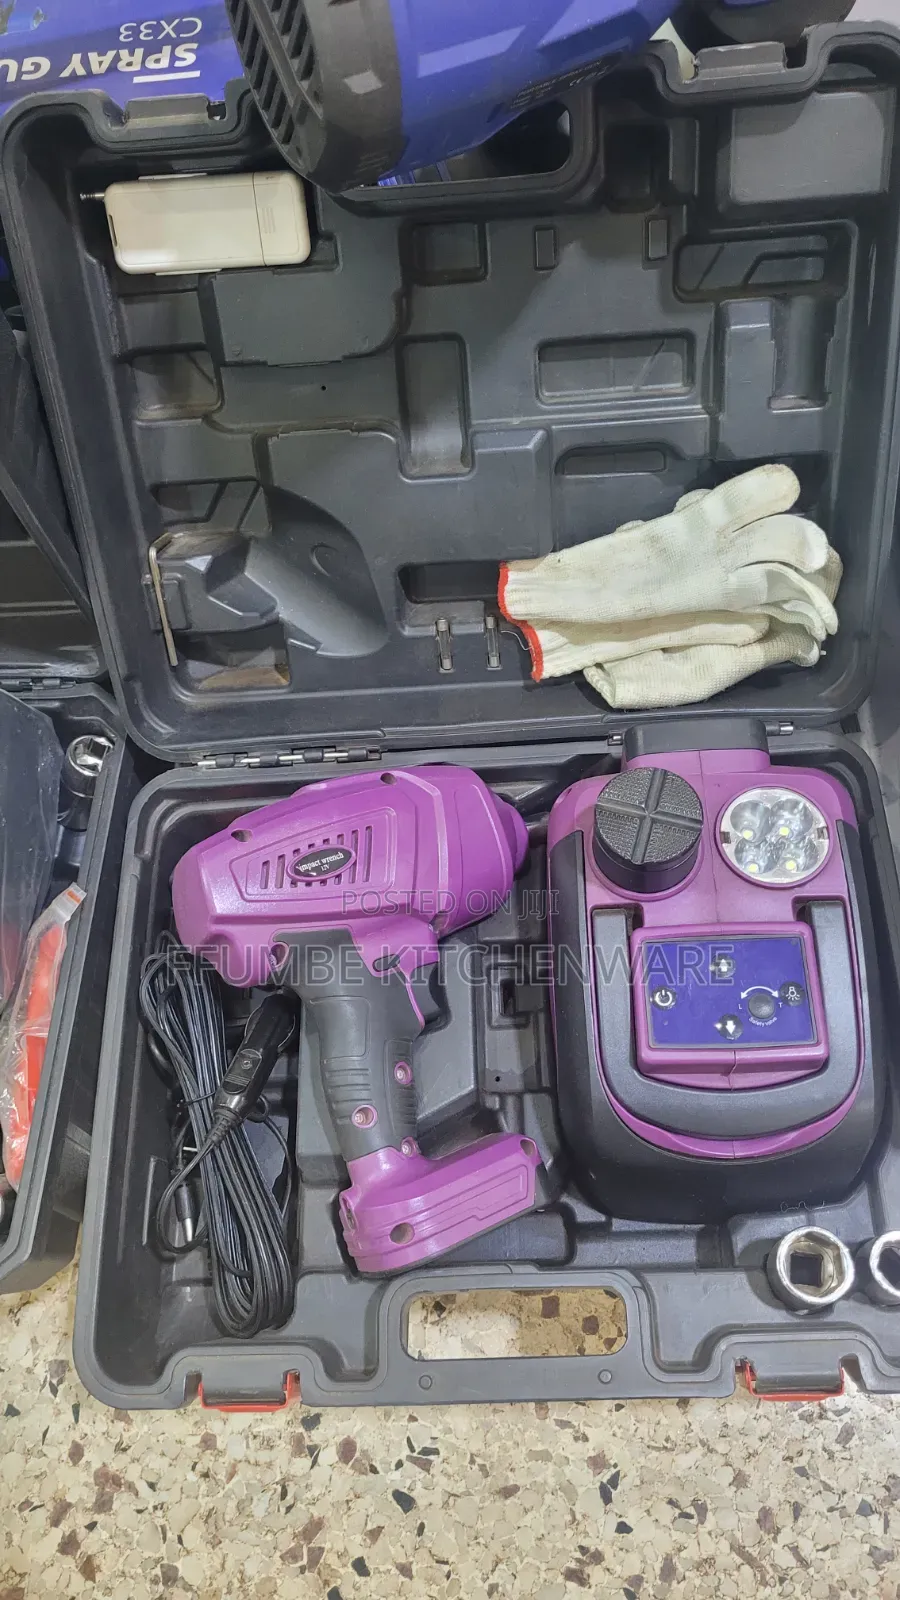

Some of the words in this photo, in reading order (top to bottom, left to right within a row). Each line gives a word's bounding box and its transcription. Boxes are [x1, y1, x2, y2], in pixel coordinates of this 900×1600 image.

[119, 17, 202, 43] CX33
[59, 43, 199, 78] SPRAY
[320, 851, 344, 863] wrench
[320, 864, 330, 872] 12V
